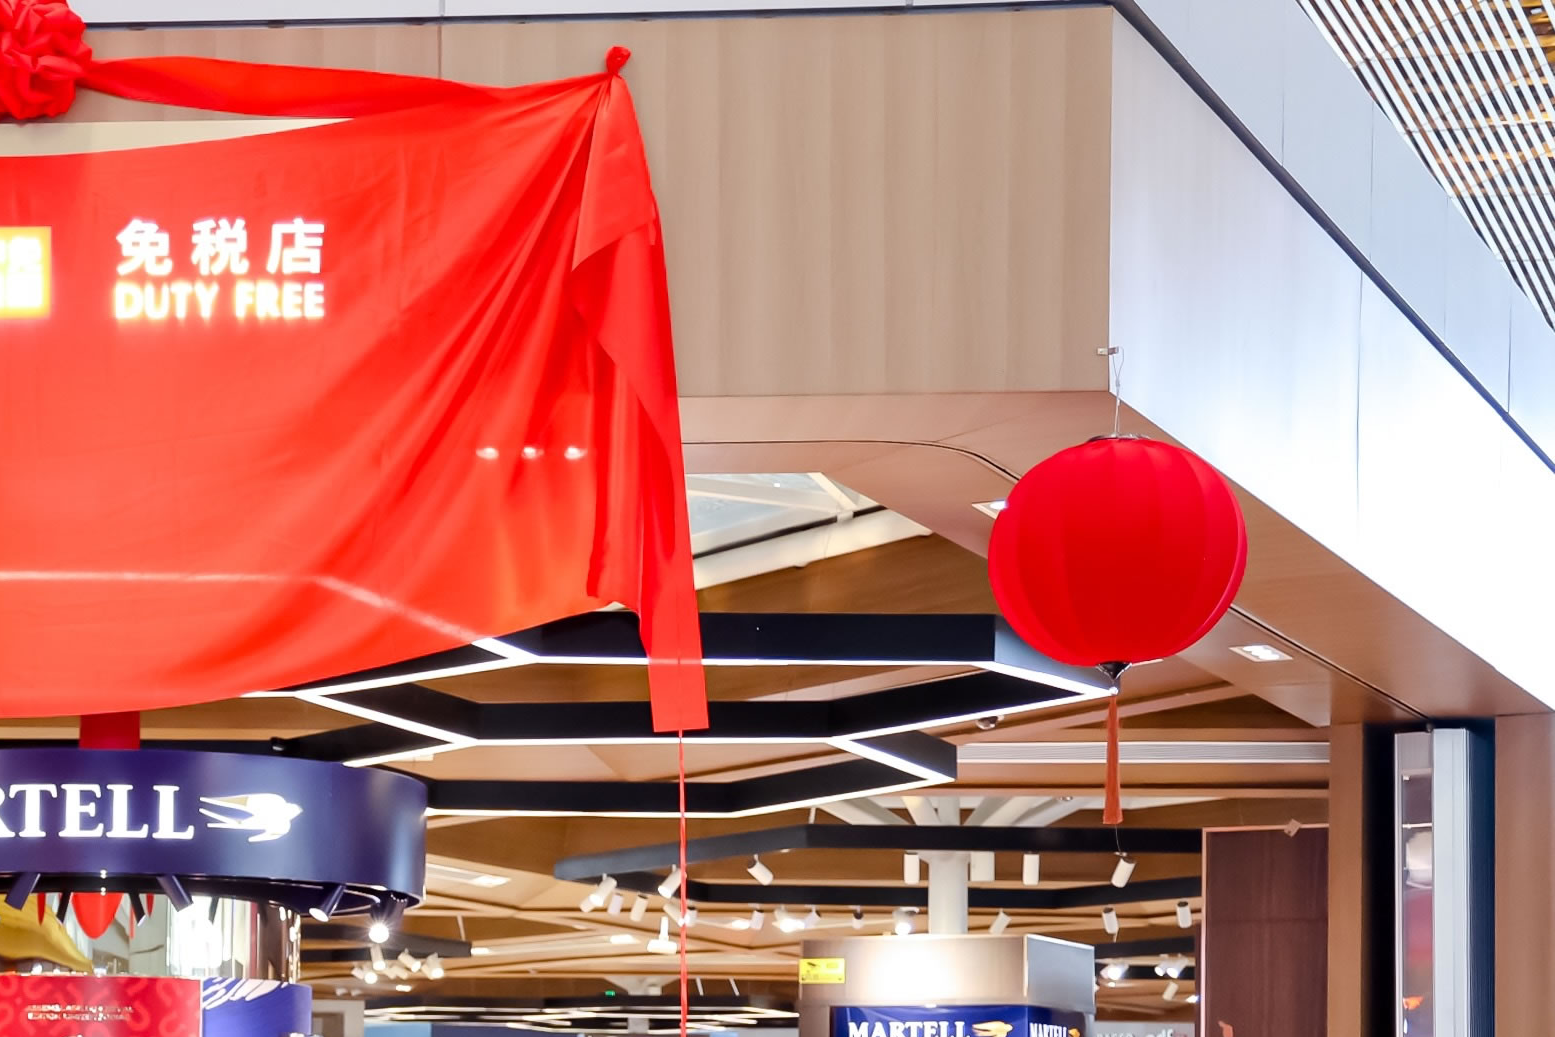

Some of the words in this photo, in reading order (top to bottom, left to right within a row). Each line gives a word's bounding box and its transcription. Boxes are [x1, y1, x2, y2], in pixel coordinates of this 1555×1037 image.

[115, 217, 325, 276] 免税店
[115, 283, 220, 320] DUTY
[235, 283, 325, 320] FREE
